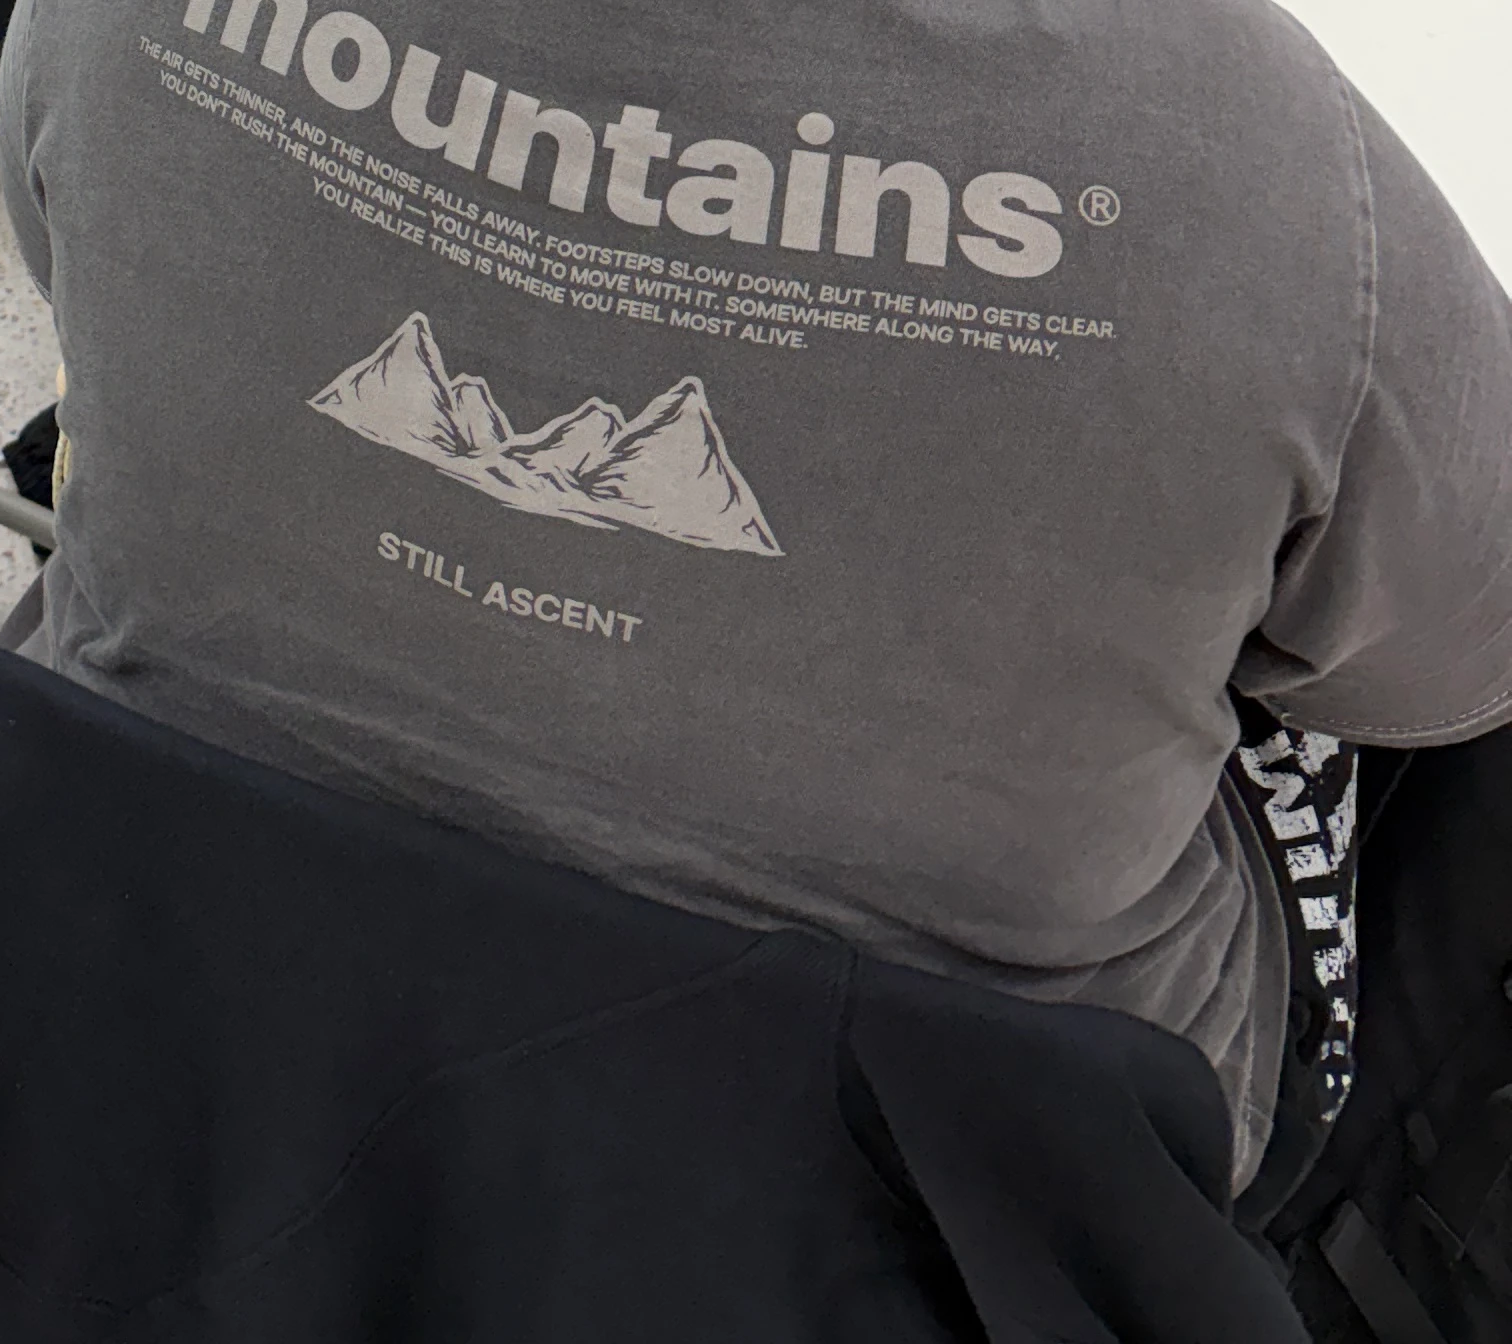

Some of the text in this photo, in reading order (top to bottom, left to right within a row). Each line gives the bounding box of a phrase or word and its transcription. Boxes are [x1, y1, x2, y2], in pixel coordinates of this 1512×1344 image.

[139, 35, 1118, 340] THE AIR GETS THINNER, AND THE NOISE FALLS AWAY. FOOTSTEPS SLOW DOWN, BUT THE MIND GETS CLEAR.
[159, 69, 187, 99] YOU
[186, 82, 230, 119] DON'T
[230, 105, 275, 144] RUSH
[276, 131, 308, 163] THE
[308, 149, 405, 213] MOUNTAIN
[430, 207, 471, 242] YOU
[472, 226, 537, 270] LEARN
[540, 257, 568, 280] TO
[569, 265, 632, 294] MOVE
[634, 277, 693, 306] WITH
[695, 290, 720, 312] IT.
[724, 295, 872, 333] SOMEWHERE
[874, 320, 955, 344] ALONG
[959, 327, 1003, 351] THE
[1006, 333, 1061, 362] WAY,
[310, 176, 810, 350] YOU REALIZE THIS IS WHERE YOU FEEL MOST ALIVE.
[377, 531, 644, 644] STILL ASCENT
